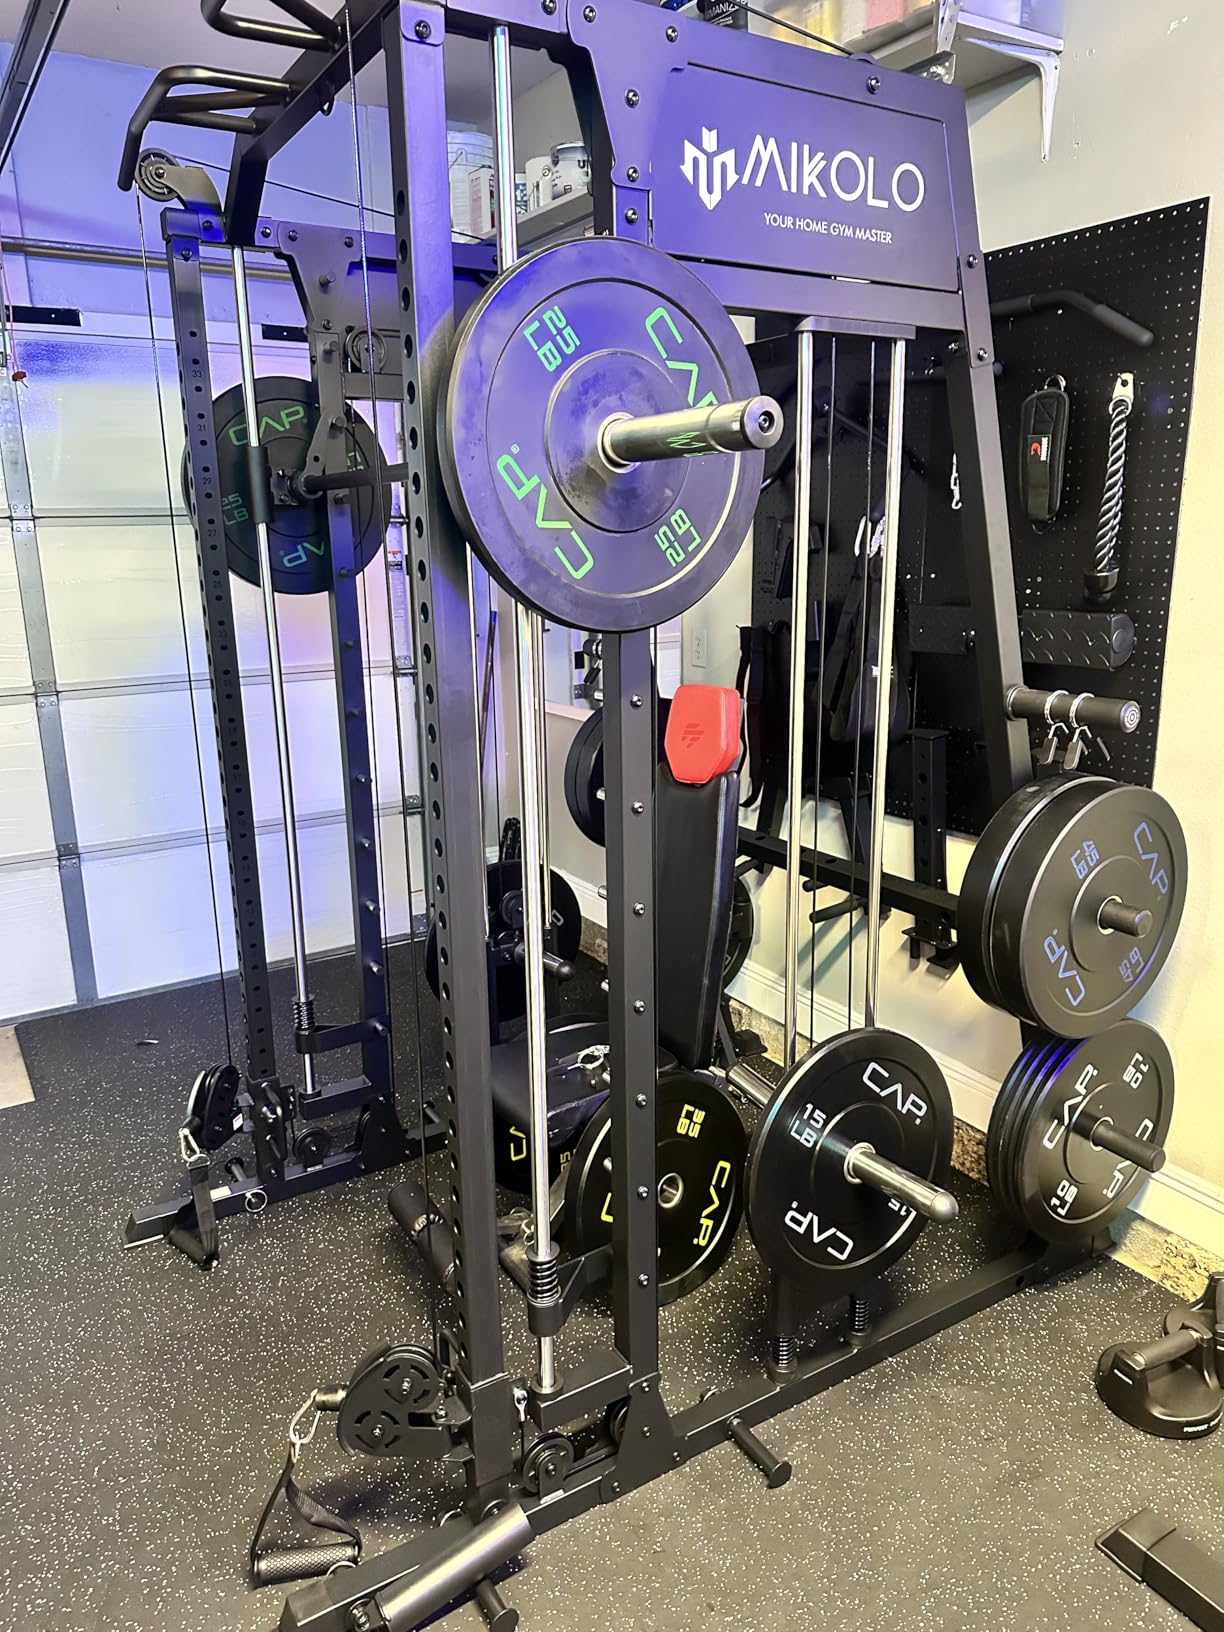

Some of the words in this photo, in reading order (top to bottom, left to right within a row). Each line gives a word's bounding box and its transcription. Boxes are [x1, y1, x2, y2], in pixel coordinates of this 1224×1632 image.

[741, 134, 925, 212] MIKOLO
[763, 212, 794, 229] YOUR
[796, 217, 828, 234] HOME
[830, 222, 854, 238] GYM
[855, 227, 892, 244] MASTER
[523, 320, 562, 372] LB
[542, 305, 580, 355] 25
[228, 405, 305, 446] CAP
[223, 507, 249, 525] LB
[496, 454, 594, 580] CAP
[669, 507, 702, 553] LB
[282, 541, 325, 568] AP
[653, 524, 686, 568] 25
[1071, 850, 1088, 880] LB
[1083, 840, 1100, 866] 45
[1134, 822, 1168, 894] CAP
[1043, 935, 1086, 1006] CAP
[862, 1061, 928, 1117] CAP
[1042, 1064, 1094, 1149] CAP
[676, 1103, 694, 1135] LB
[688, 1108, 706, 1138] 35
[790, 1119, 818, 1148] LB
[803, 1103, 827, 1129] 15
[698, 1160, 731, 1246] CAP
[784, 1210, 854, 1261] CAP
